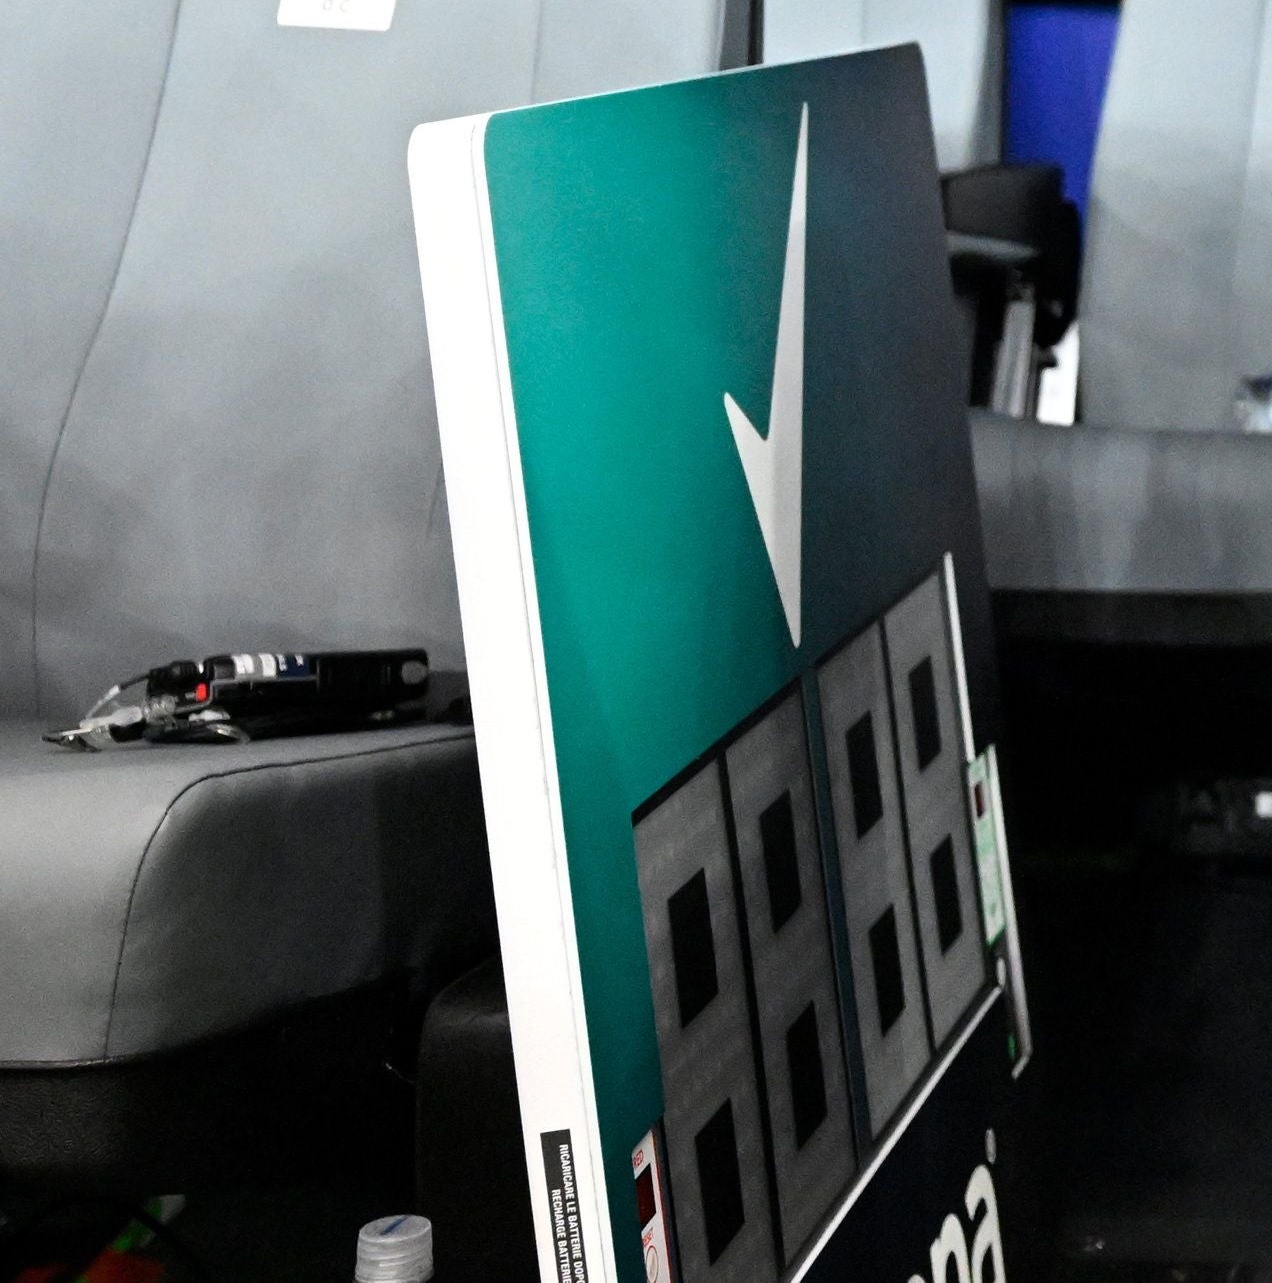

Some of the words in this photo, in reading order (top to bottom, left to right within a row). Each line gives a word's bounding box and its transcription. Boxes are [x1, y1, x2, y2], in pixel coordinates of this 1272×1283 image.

[559, 1144, 575, 1200] RICARICARE
[552, 1189, 566, 1238] RECHARGE
[566, 1201, 577, 1213] LE
[567, 1215, 582, 1259] BATTERIE
